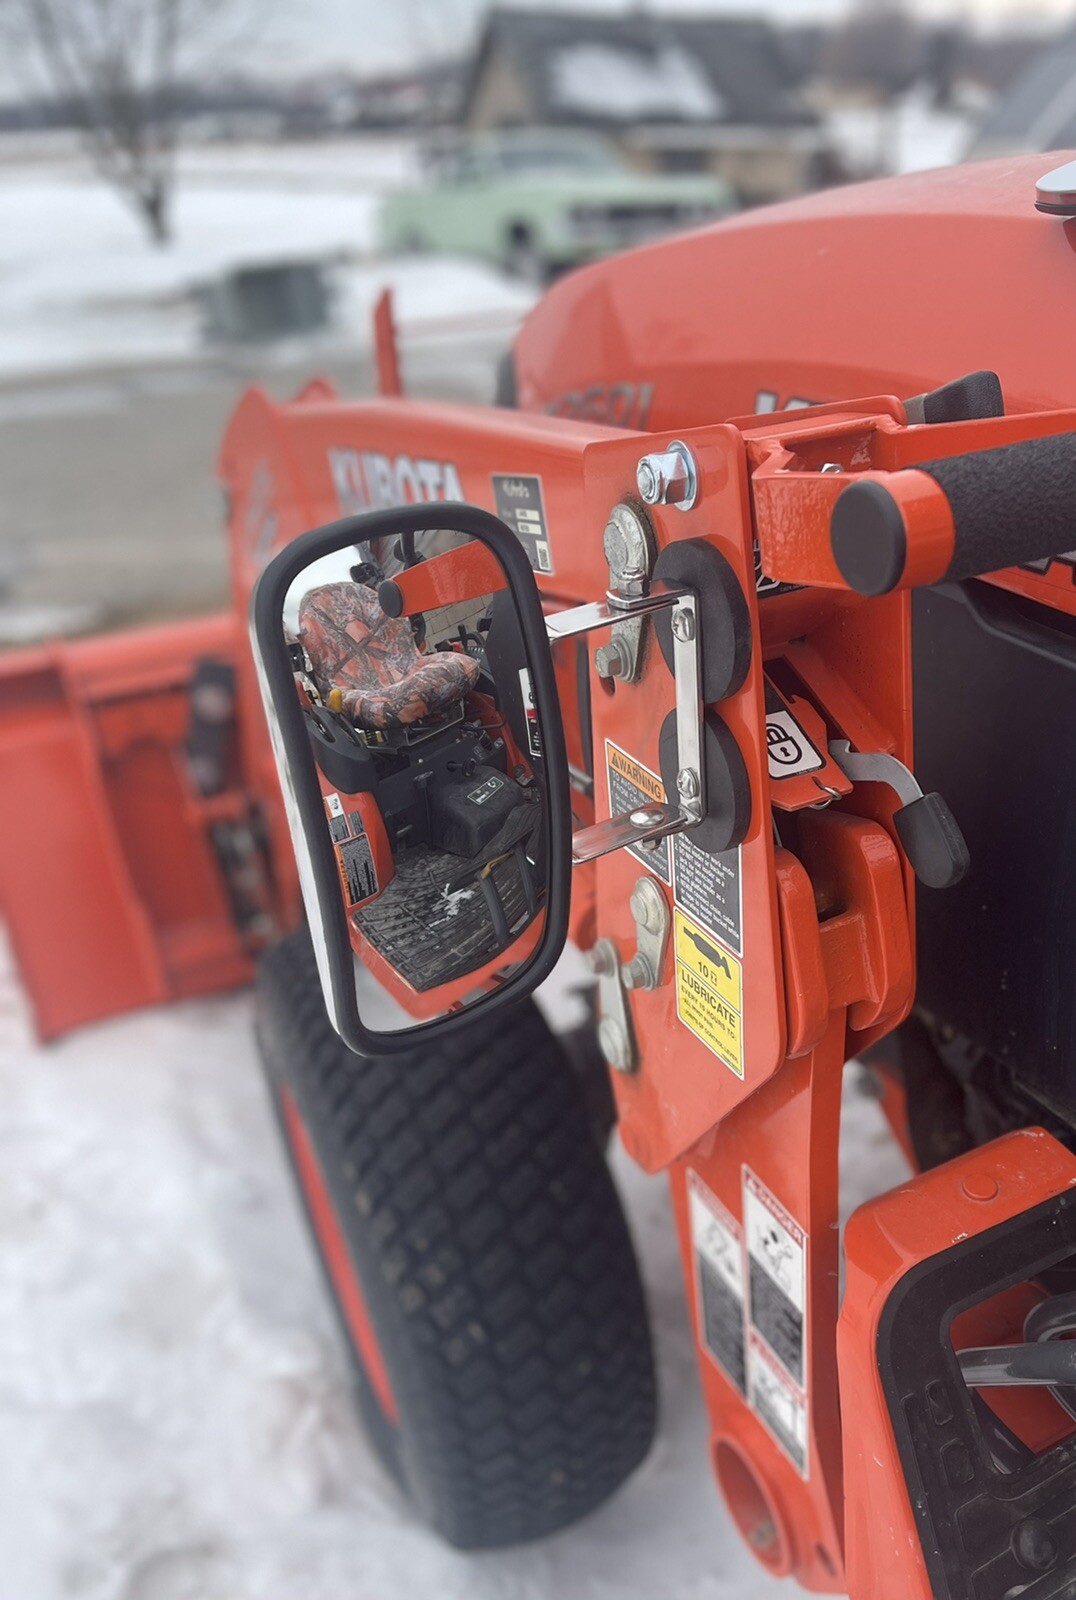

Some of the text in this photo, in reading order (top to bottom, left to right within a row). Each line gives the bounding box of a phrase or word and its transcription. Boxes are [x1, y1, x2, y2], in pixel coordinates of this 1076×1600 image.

[326, 445, 465, 516] KUBOTA
[618, 755, 662, 800] WARNING
[698, 961, 710, 978] 10
[680, 985, 698, 1004] EVERY
[681, 969, 736, 1028] LUBRICATE
